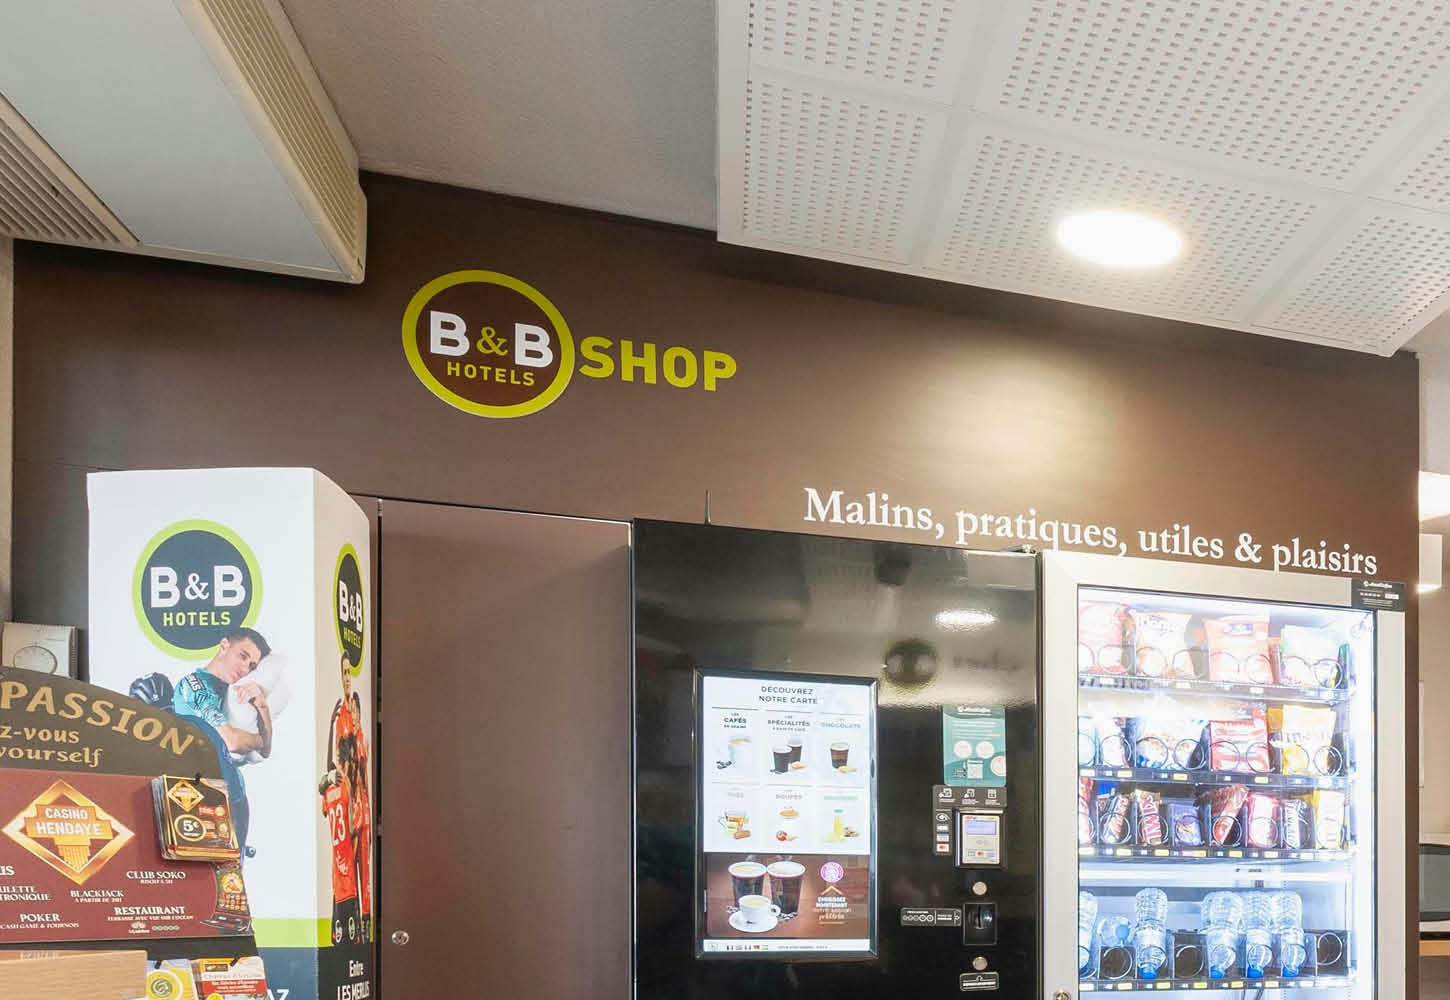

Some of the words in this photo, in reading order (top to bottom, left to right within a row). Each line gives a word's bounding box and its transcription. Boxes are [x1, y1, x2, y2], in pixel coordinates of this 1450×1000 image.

[430, 310, 554, 368] B&B
[579, 336, 737, 391] SHOP
[447, 361, 535, 386] HOTELS
[803, 487, 945, 539] Malins,
[955, 507, 1128, 557] pratiques,
[1138, 523, 1224, 559] utiles
[1234, 532, 1262, 564] &
[1271, 537, 1377, 576] plaisirs
[150, 564, 246, 608] B&B
[338, 580, 363, 633] B&B
[163, 611, 231, 626] HOTELS
[343, 622, 361, 648] HOTELS
[759, 695, 787, 703] NOTRE
[790, 696, 818, 704] CARTE
[0, 681, 194, 755] PASSION
[45, 806, 88, 820] CASINO
[36, 822, 101, 836] HENDAYE
[126, 870, 154, 879] CLUB
[156, 871, 186, 880] SOKO
[70, 890, 124, 898] BLACKJACK
[20, 913, 60, 922] POKER
[114, 906, 185, 915] RESTAURANT
[349, 960, 364, 977] Entre
